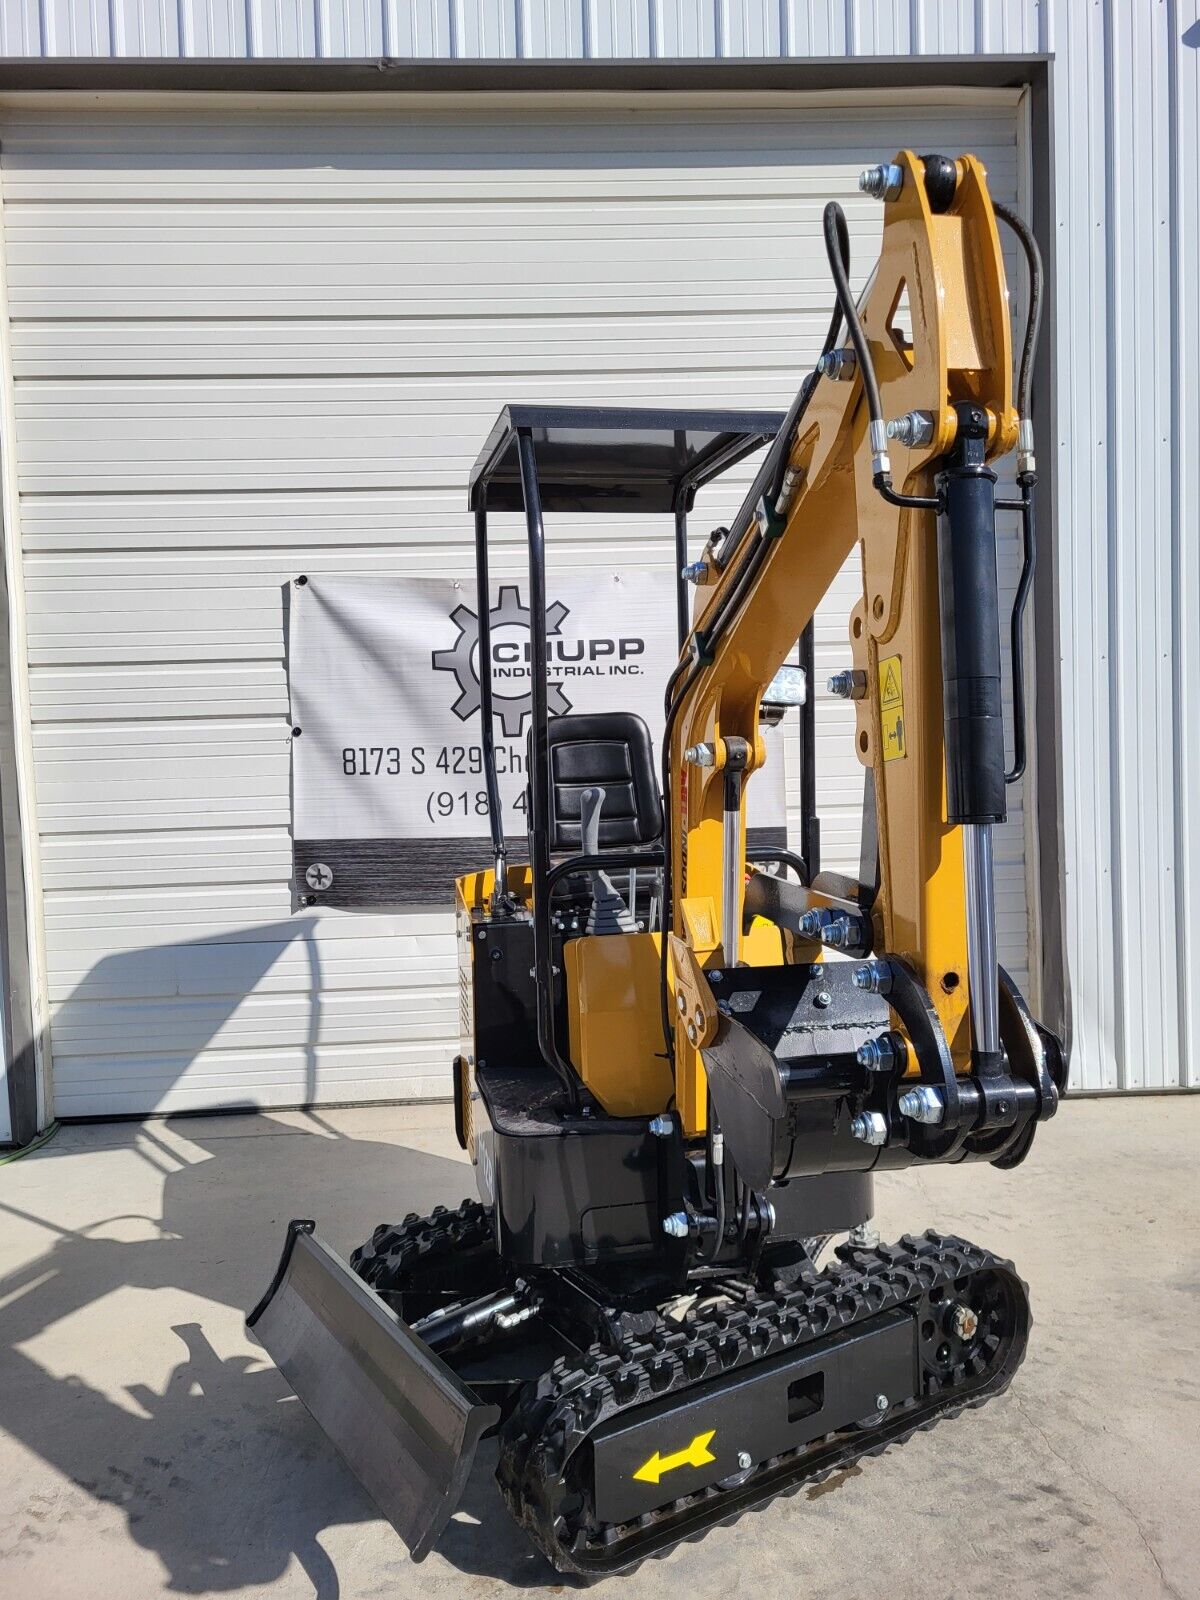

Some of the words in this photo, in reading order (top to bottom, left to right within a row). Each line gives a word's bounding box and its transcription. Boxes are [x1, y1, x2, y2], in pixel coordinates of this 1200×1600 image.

[492, 638, 645, 663] CHUPP
[493, 666, 605, 678] INDUSTRIAL
[609, 665, 644, 675] INC.
[343, 747, 401, 776] 8173
[411, 747, 425, 775] S
[435, 746, 483, 774] 429
[494, 746, 528, 774] Ch
[512, 790, 527, 815] 4
